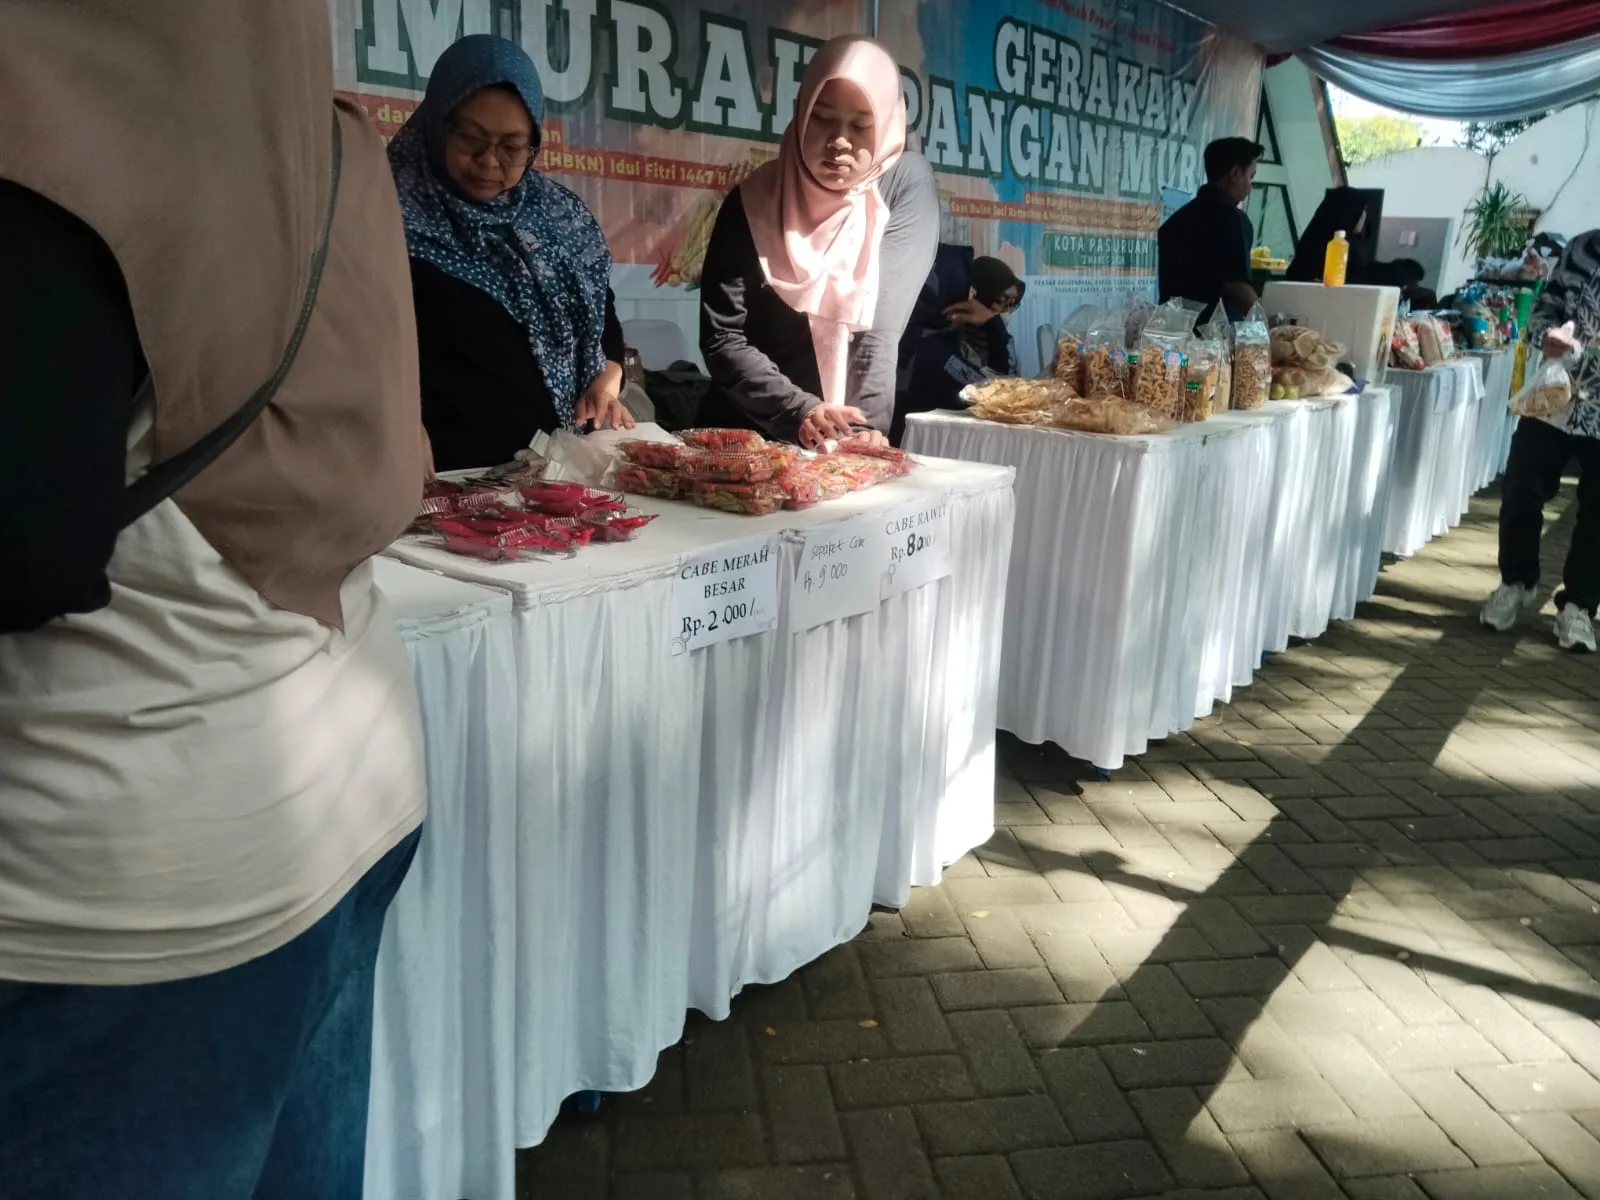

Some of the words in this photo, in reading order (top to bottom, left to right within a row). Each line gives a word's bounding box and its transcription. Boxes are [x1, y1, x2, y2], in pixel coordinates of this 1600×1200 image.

[995, 20, 1198, 135] GERAKAN
[543, 150, 605, 176] (HBKN)
[610, 157, 640, 175] Idul
[645, 162, 676, 181] Fitri
[718, 171, 727, 185] H
[1054, 235, 1084, 251] KOTA
[1088, 238, 1149, 254] PASURUAN
[885, 515, 915, 535] CABE
[681, 560, 719, 580] CABE
[722, 548, 769, 572] MERAH
[704, 577, 746, 599] BESAR
